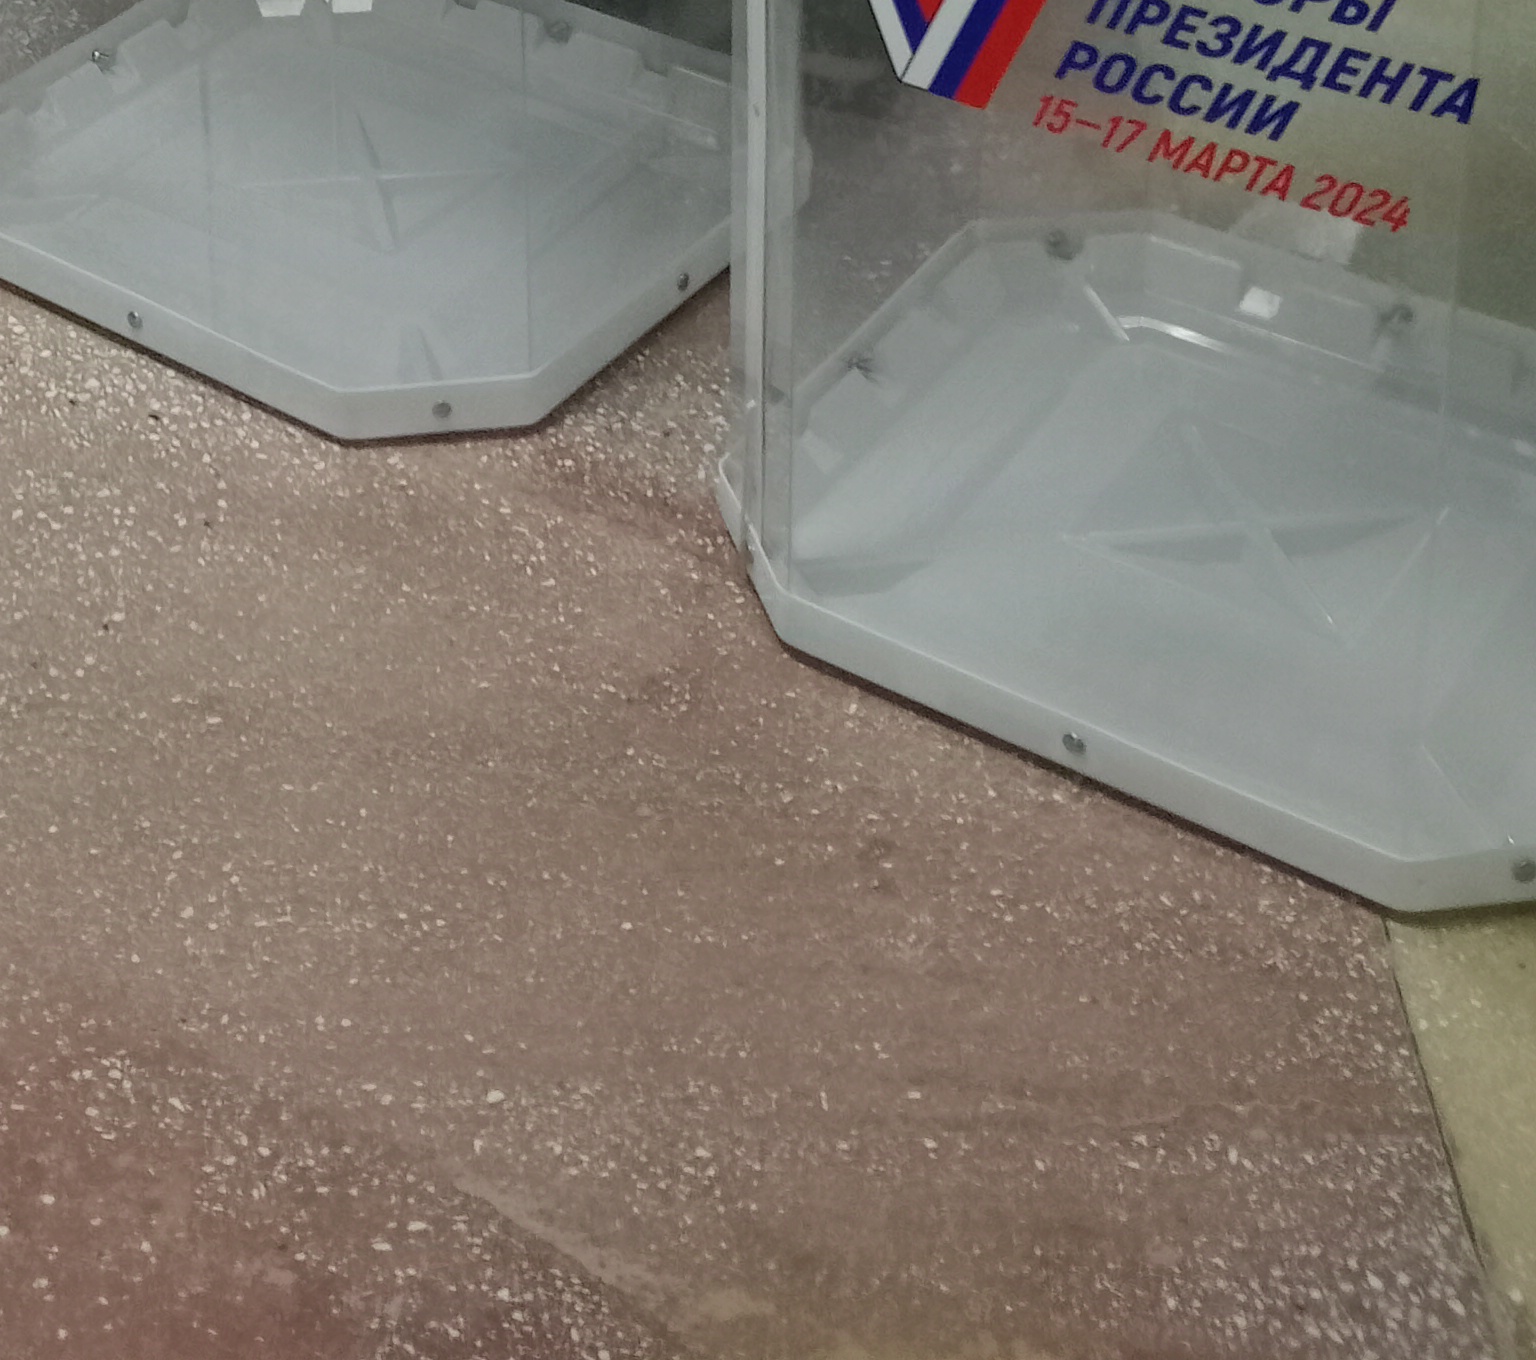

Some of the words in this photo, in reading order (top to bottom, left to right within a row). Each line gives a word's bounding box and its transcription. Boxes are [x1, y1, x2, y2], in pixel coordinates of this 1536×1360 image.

[1054, 40, 1302, 142] РОССИИ
[1147, 128, 1297, 202] МАРТА
[1299, 173, 1412, 233] 2024
